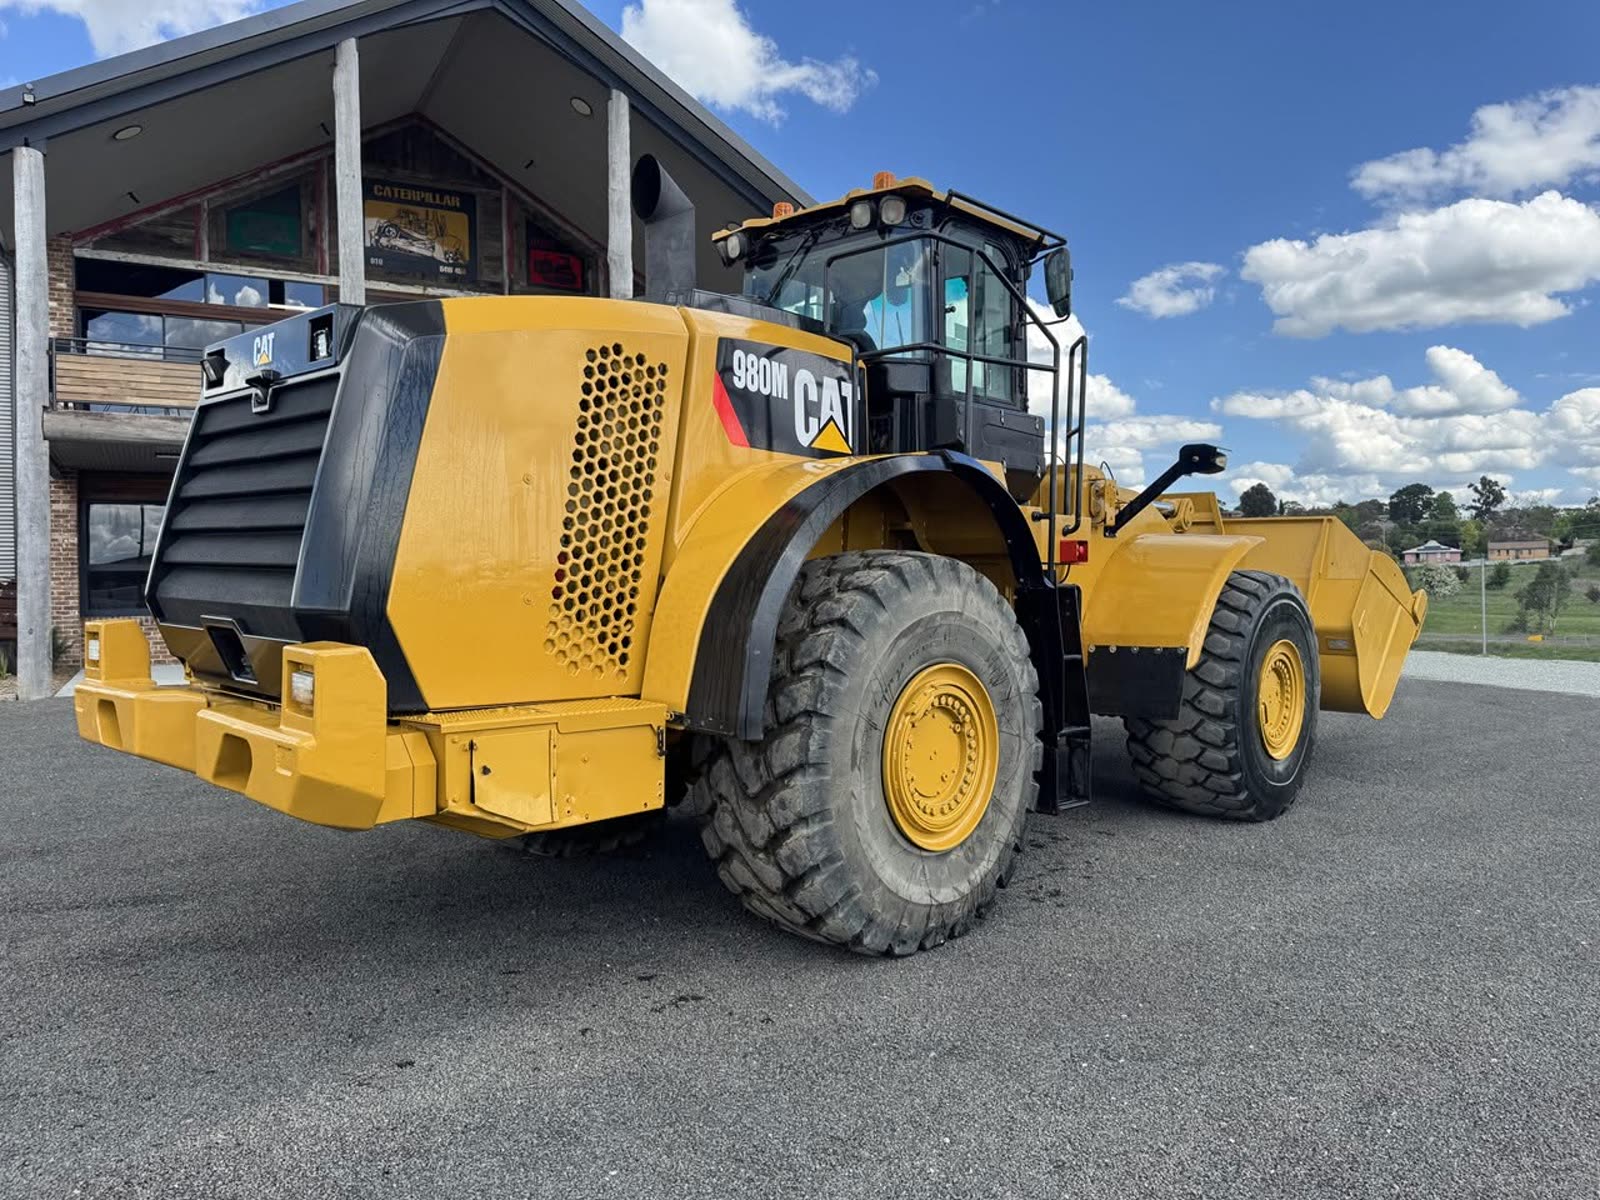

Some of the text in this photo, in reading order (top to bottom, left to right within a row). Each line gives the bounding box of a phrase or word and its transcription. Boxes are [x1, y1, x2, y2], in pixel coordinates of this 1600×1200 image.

[373, 184, 460, 207] CATERPILLAR
[253, 332, 275, 367] CAT
[733, 349, 788, 400] 980M
[794, 368, 861, 451] CAT
